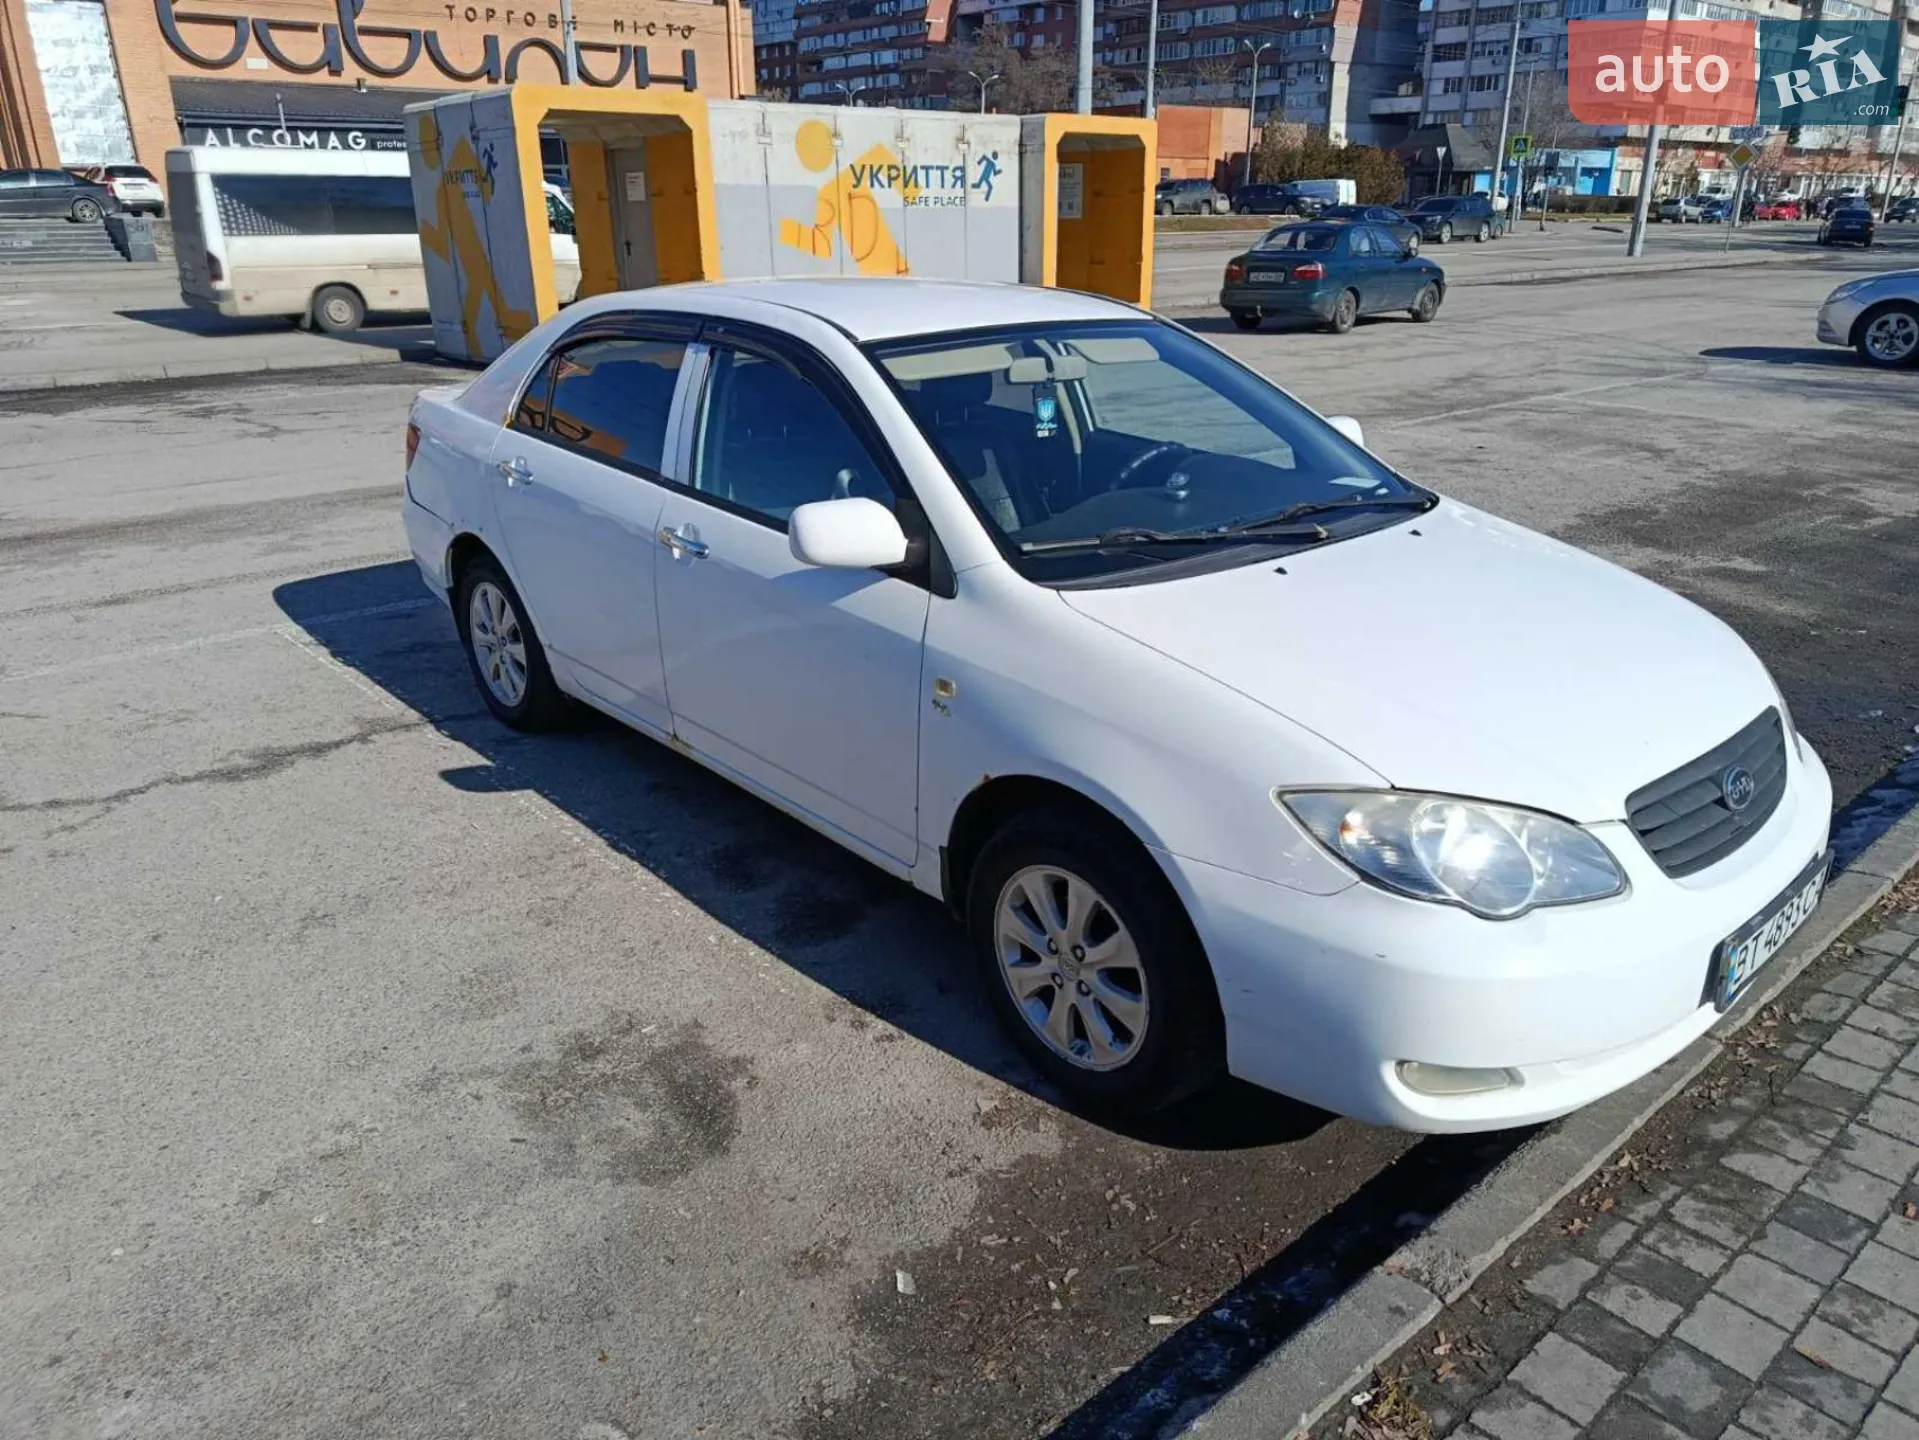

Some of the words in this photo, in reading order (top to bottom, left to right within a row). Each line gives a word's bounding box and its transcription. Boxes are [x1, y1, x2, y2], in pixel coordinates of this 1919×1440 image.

[613, 18, 696, 40] МІСТО
[204, 126, 367, 151] ALCOMAG
[850, 163, 966, 189] УКРИТТЯ
[903, 196, 930, 208] SAFE
[933, 196, 966, 208] PLACE
